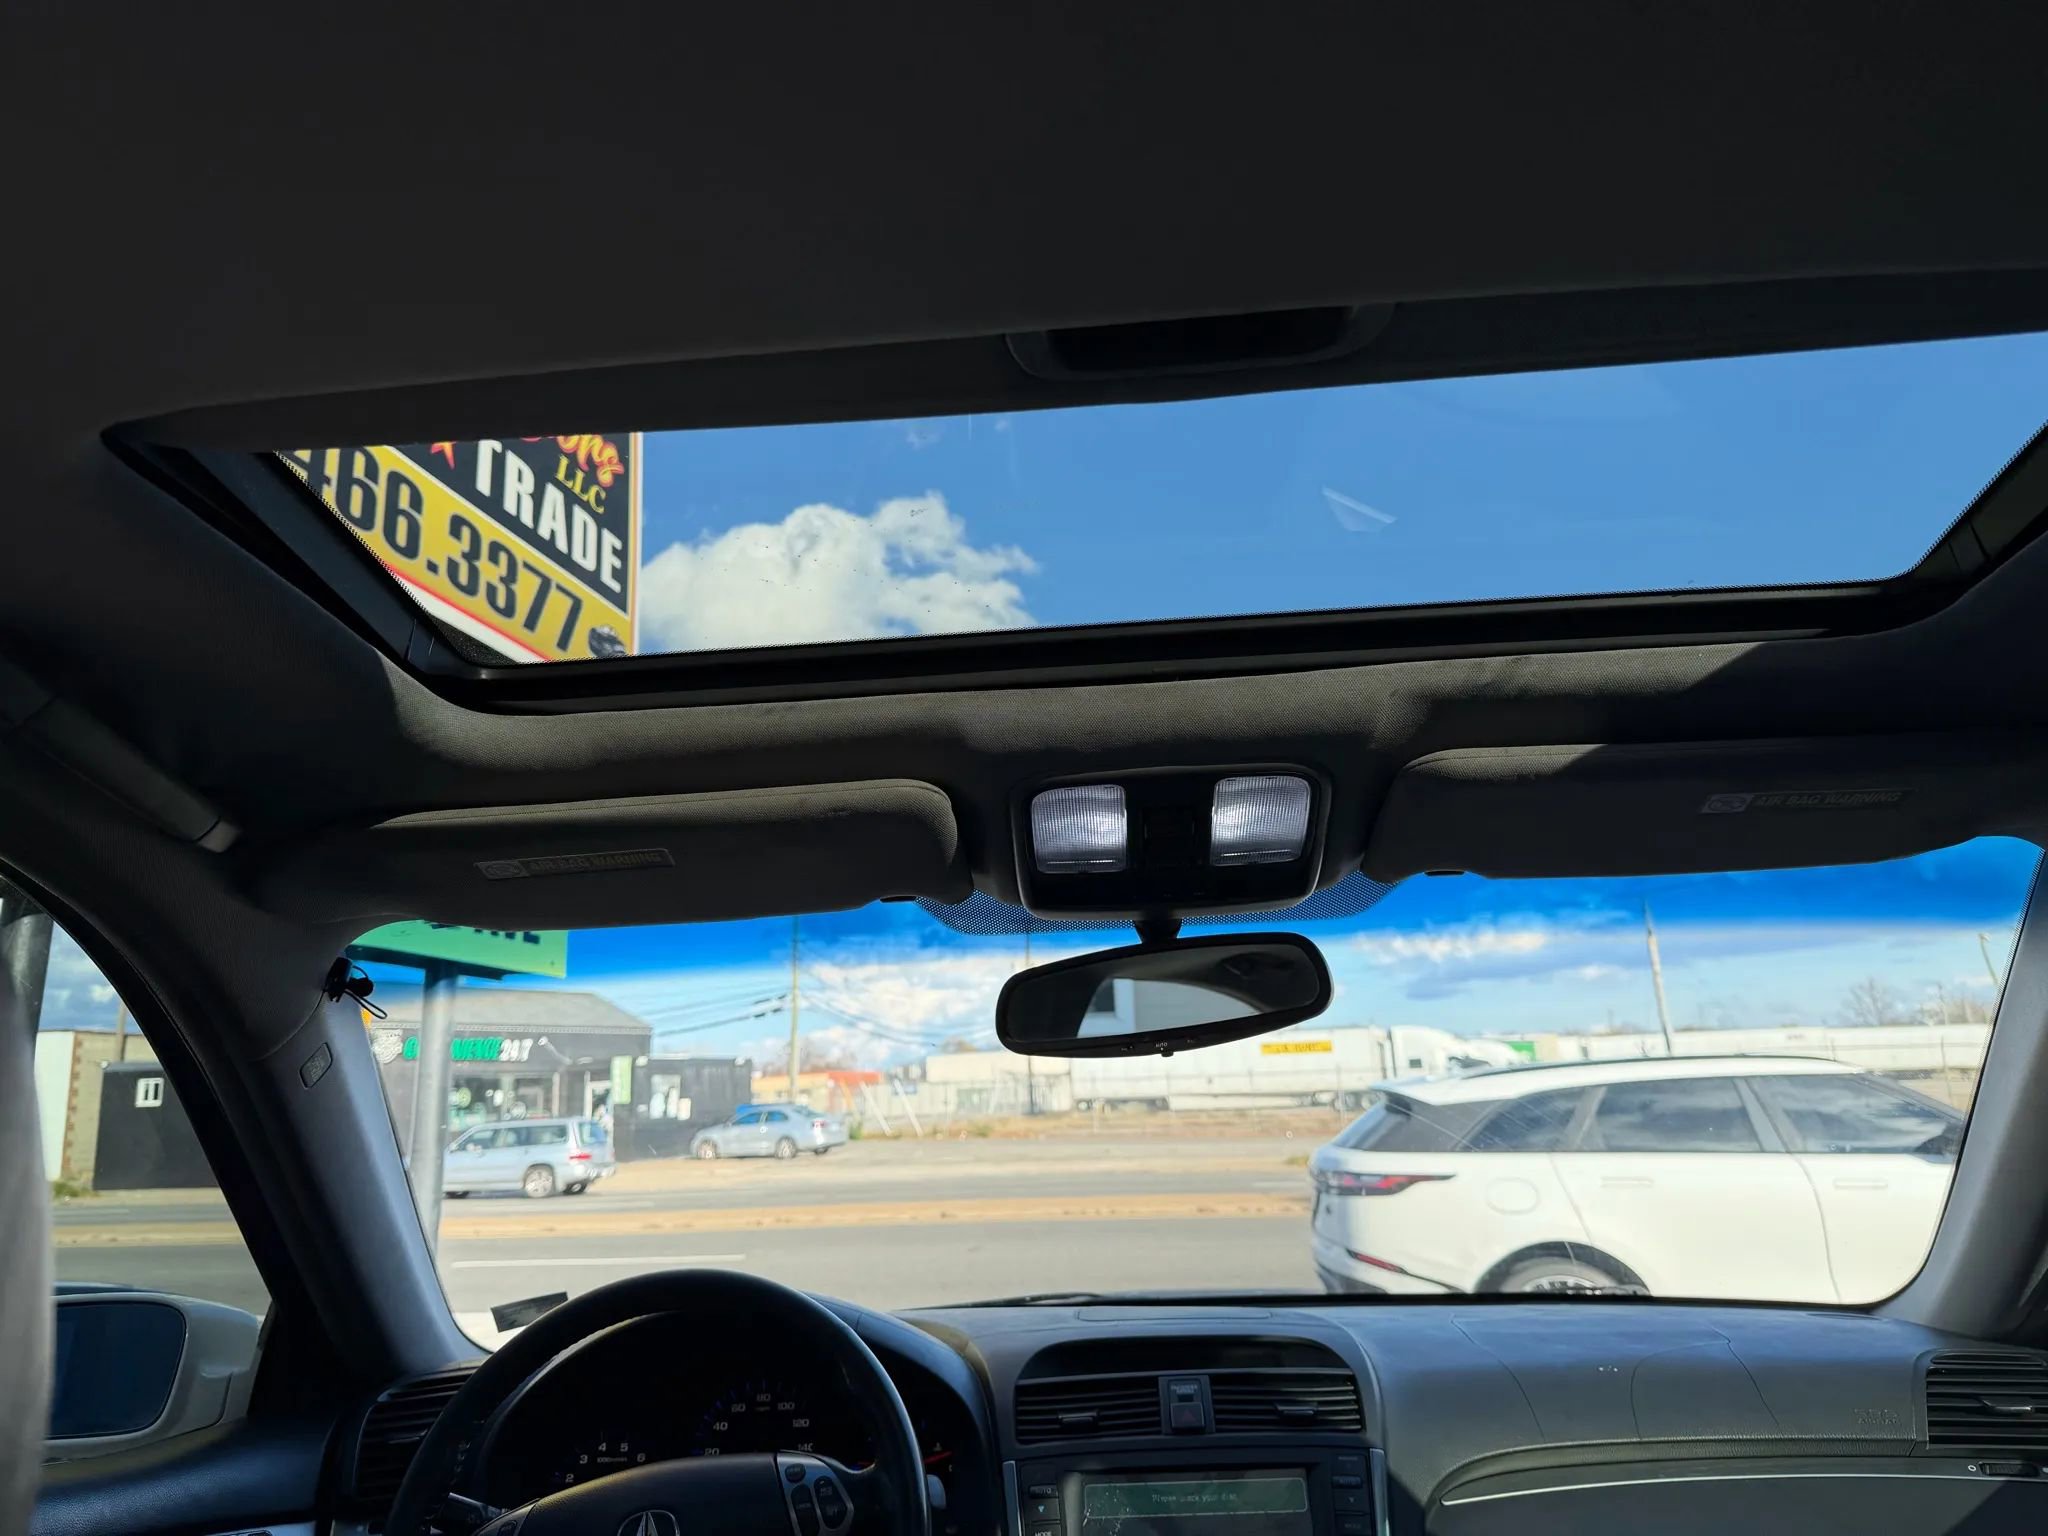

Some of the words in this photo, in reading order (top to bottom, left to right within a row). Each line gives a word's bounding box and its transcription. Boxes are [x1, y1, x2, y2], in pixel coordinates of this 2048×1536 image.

[554, 453, 607, 515] LLC
[475, 438, 623, 594] TRADE
[712, 1421, 728, 1431] 40
[598, 1442, 607, 1452] 4
[620, 1442, 629, 1453] 5
[579, 1454, 589, 1464] 3
[565, 1473, 575, 1483] 2
